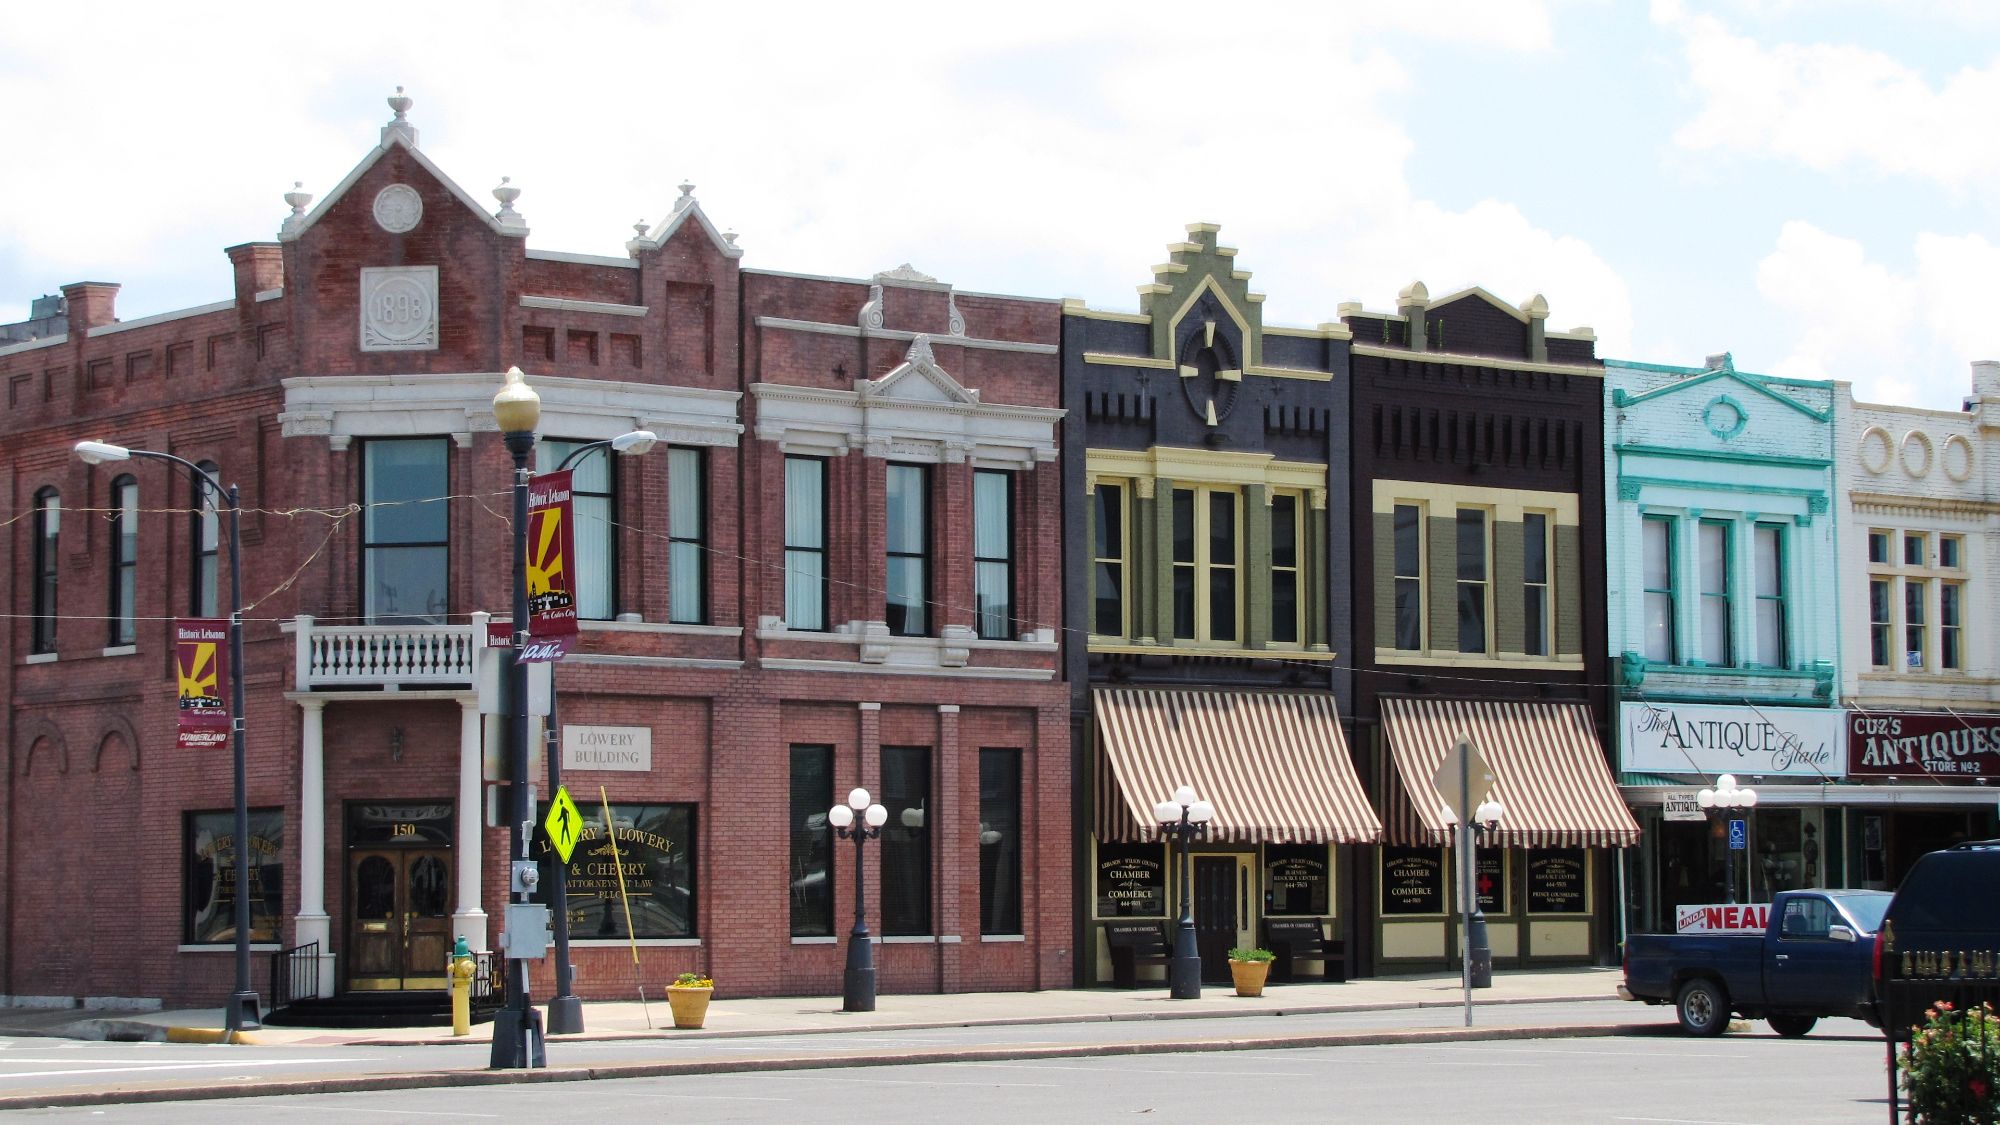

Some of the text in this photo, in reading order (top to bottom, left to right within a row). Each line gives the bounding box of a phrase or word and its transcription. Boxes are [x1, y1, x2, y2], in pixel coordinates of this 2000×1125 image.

[374, 294, 422, 324] 1898
[529, 488, 570, 508] Historic Lebanon
[541, 612, 550, 620] The
[565, 610, 576, 618] City
[178, 628, 226, 640] Historic Lebanon
[489, 634, 511, 646] Historic
[1637, 706, 1776, 757] The ANTIQUE
[1854, 716, 1902, 735] CUZ'S
[179, 732, 227, 743] CUMBERLAND
[579, 733, 636, 746] LOWERY
[1771, 732, 1830, 771] Glade
[1861, 726, 2000, 766] ANTIQUES
[575, 750, 640, 764] BUILDING
[1923, 761, 1957, 772] STORE
[393, 823, 416, 837] 150
[616, 827, 675, 854] LOWERY
[571, 862, 647, 876] & CHERRY
[1110, 870, 1150, 878] CHAMBER
[634, 879, 654, 888] LAW
[598, 890, 621, 899] PLLC
[1108, 890, 1152, 898] COMMERCE
[1391, 887, 1432, 895] COMMERCE
[1706, 906, 1771, 930] NEAL
